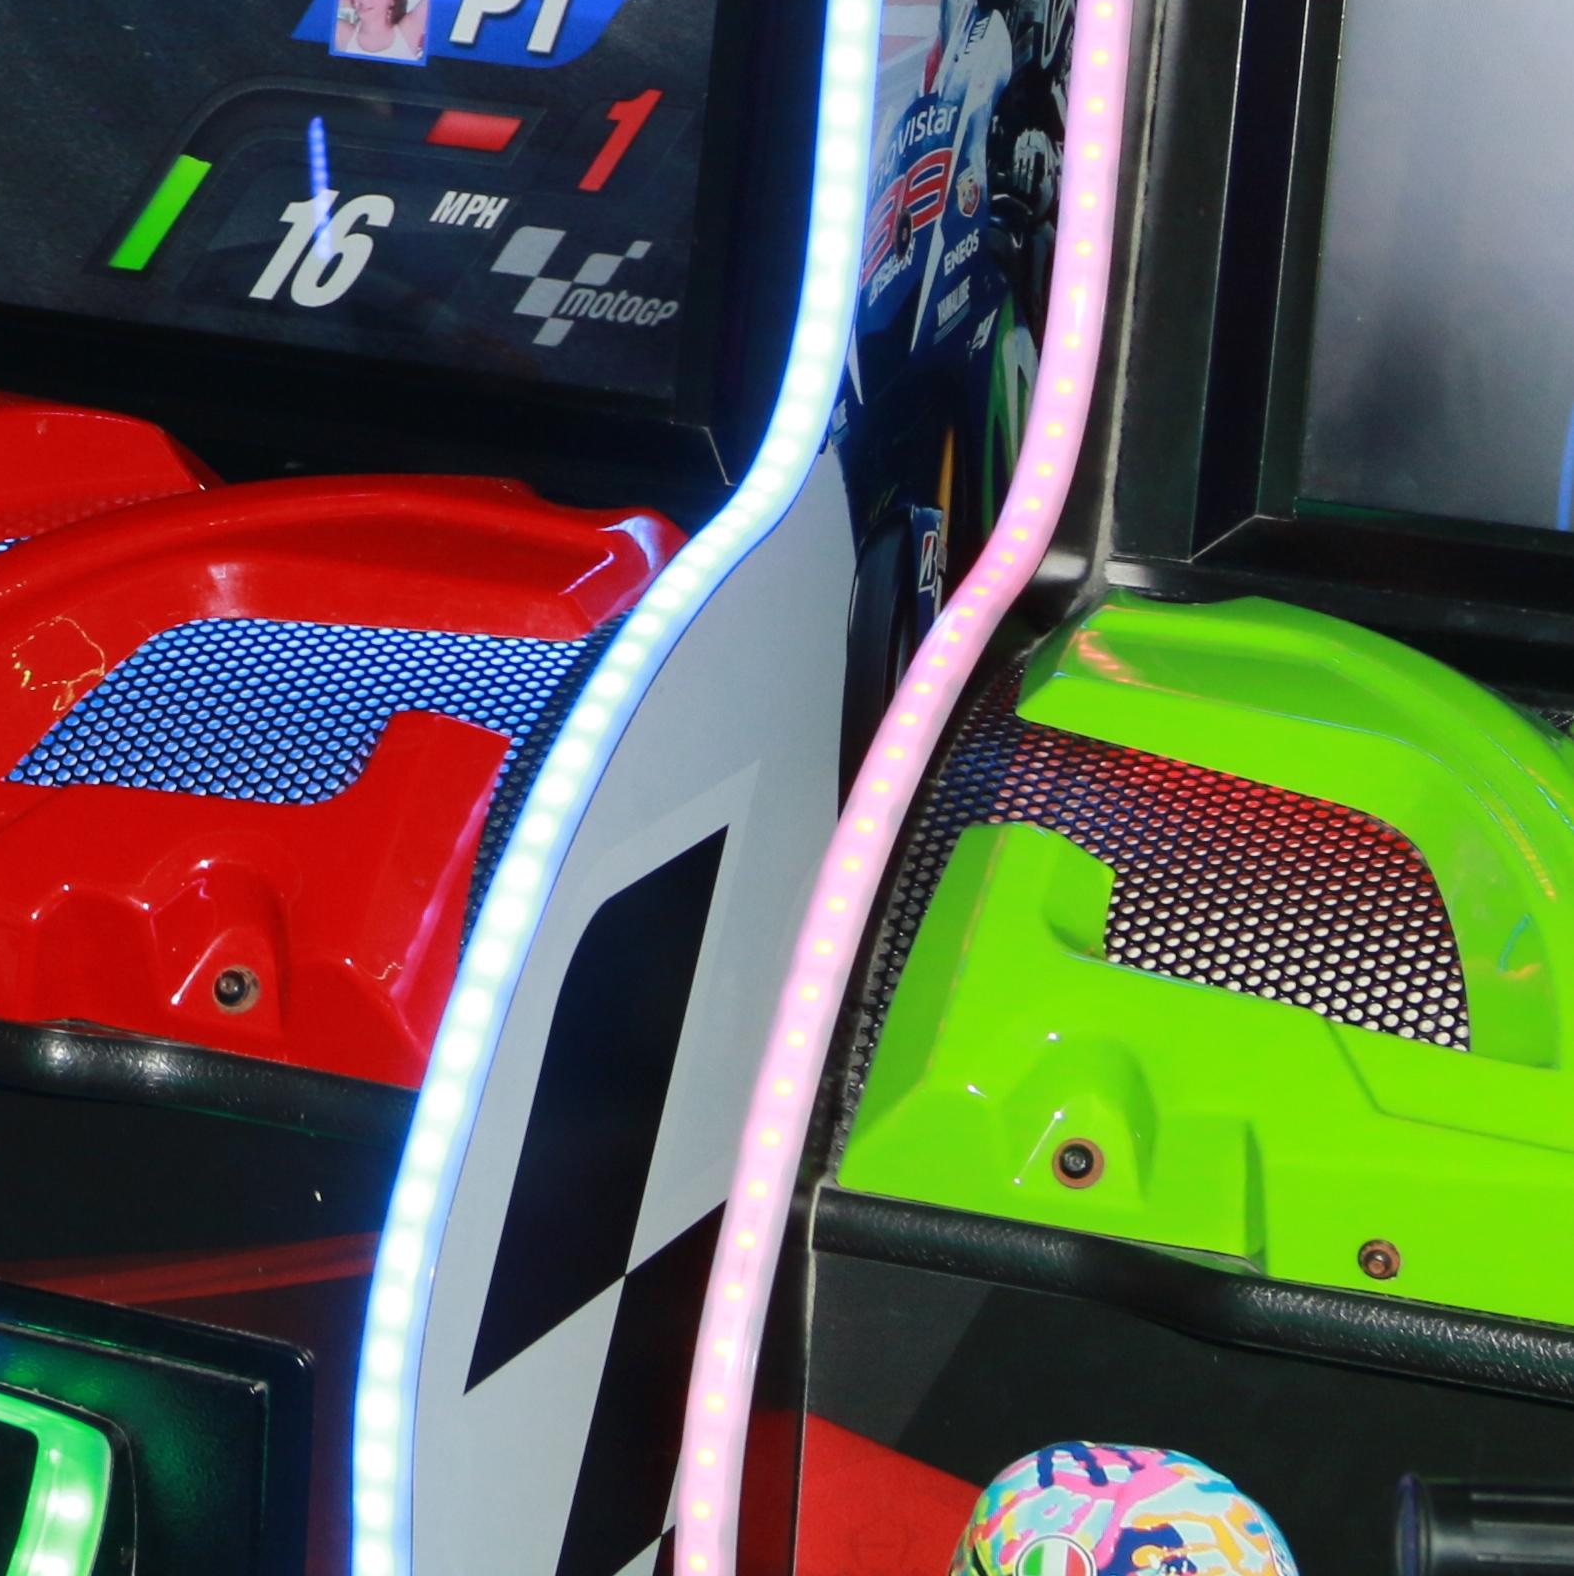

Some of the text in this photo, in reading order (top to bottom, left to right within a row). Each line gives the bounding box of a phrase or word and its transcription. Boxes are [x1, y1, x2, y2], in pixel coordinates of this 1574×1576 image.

[577, 88, 664, 192] 1
[248, 188, 396, 308] 16
[430, 191, 509, 230] MPH
[944, 228, 980, 276] ENEOS
